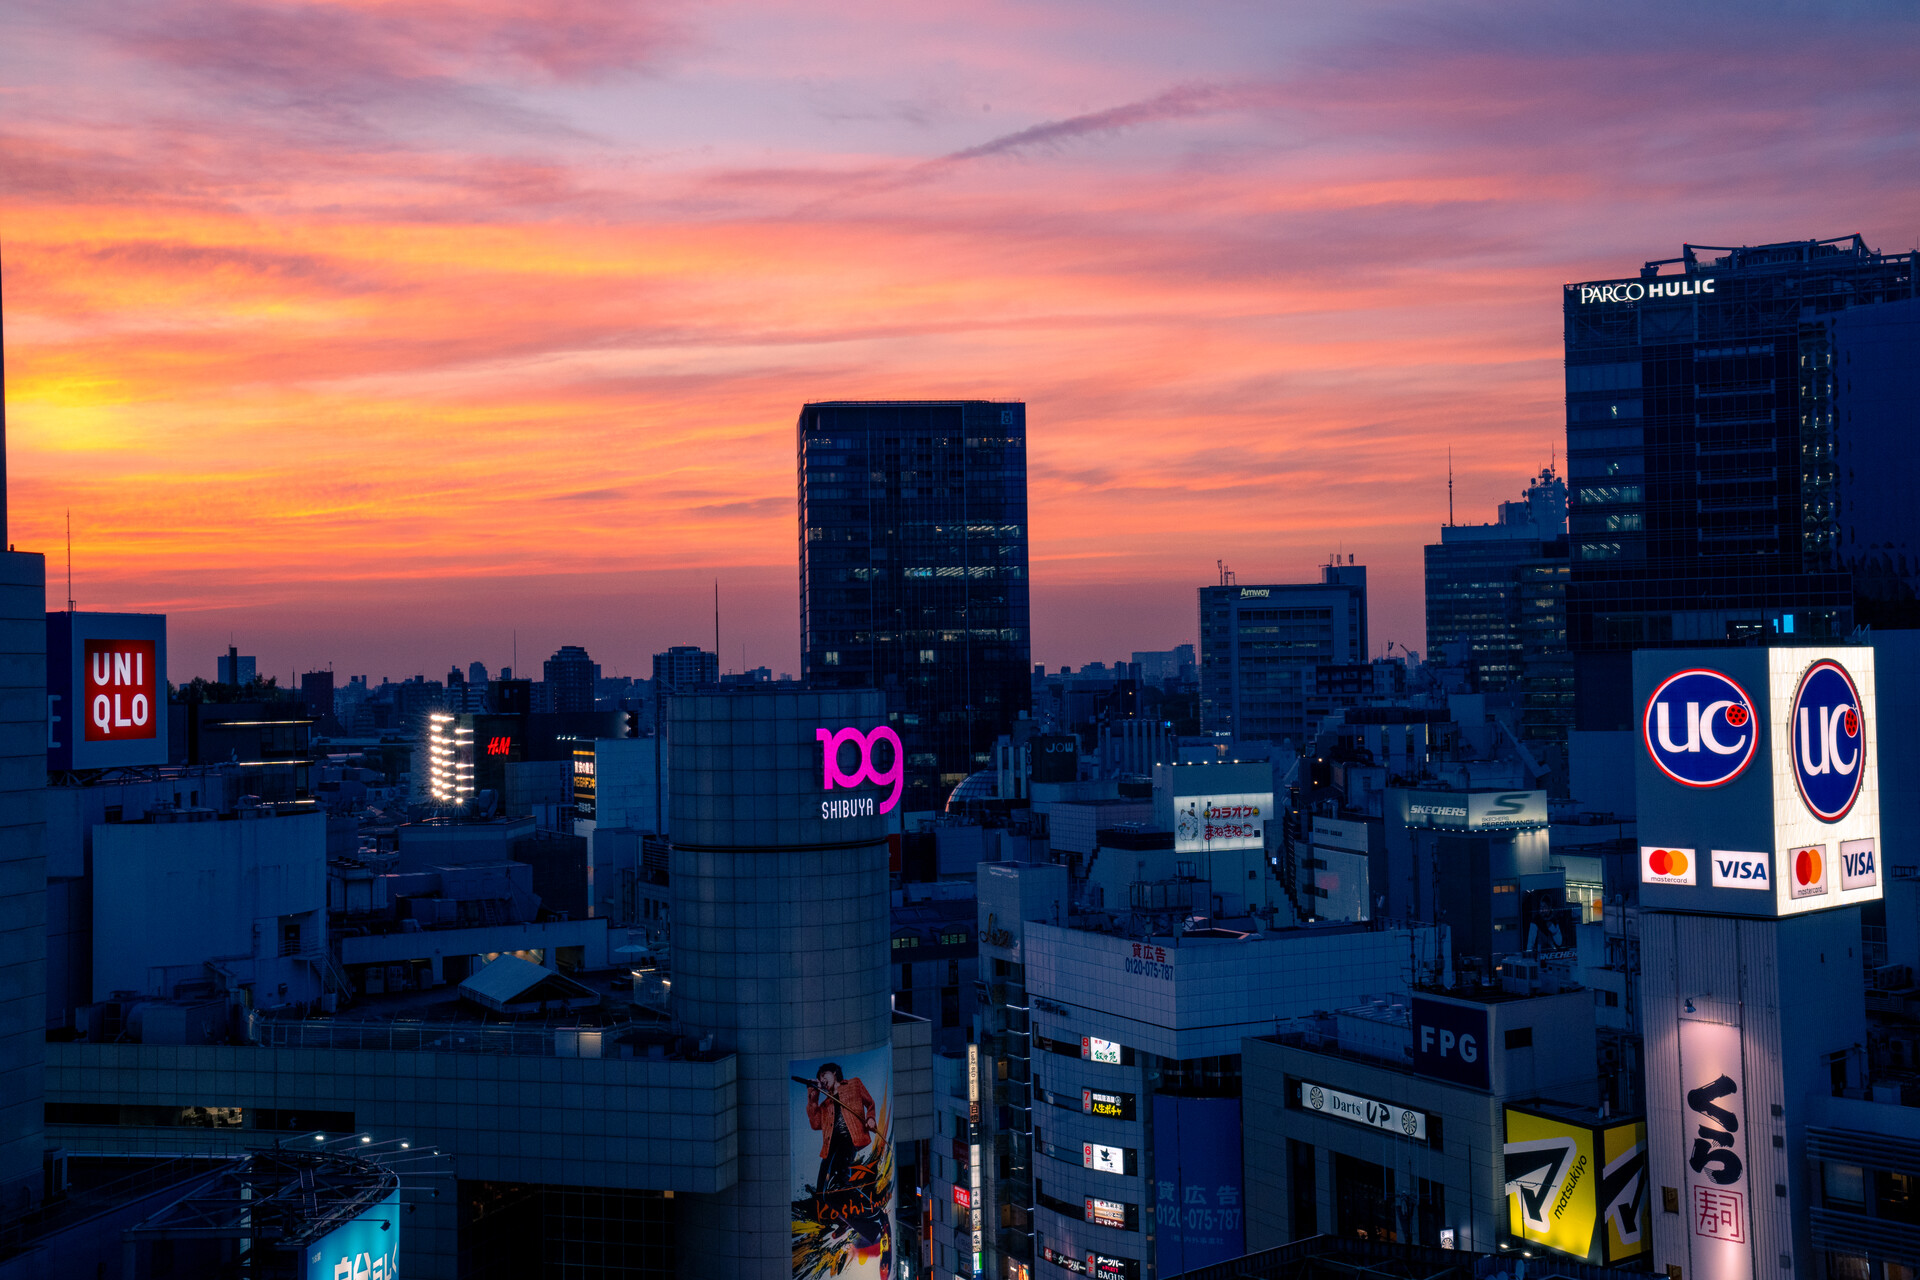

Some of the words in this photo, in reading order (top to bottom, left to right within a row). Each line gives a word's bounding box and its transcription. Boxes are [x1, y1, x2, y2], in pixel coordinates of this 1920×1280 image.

[1581, 284, 1645, 304] PARCO
[1649, 279, 1715, 298] HULIC
[1240, 587, 1270, 598] Amway
[93, 652, 143, 686] UNI
[93, 693, 148, 734] QLO
[487, 736, 511, 756] H&M
[816, 725, 904, 815] 109
[821, 798, 874, 820] SHIBUYA
[1210, 806, 1252, 819] カラオケ
[1410, 805, 1468, 817] SKECHERS
[1204, 824, 1253, 841] まねきねこ
[1481, 820, 1535, 828] PERFORMANCE
[1714, 860, 1768, 881] VISA
[1842, 852, 1875, 878] VISA
[1650, 876, 1688, 884] mastercard
[1797, 884, 1823, 897] mastercard
[1132, 943, 1166, 963] 貸広告
[1420, 1024, 1478, 1063] FPG
[1333, 1095, 1361, 1116] Darts
[1366, 1101, 1390, 1127] UP
[1687, 1074, 1743, 1185] くら
[1554, 1155, 1588, 1221] matsukiyo
[816, 1194, 865, 1223] Koshi
